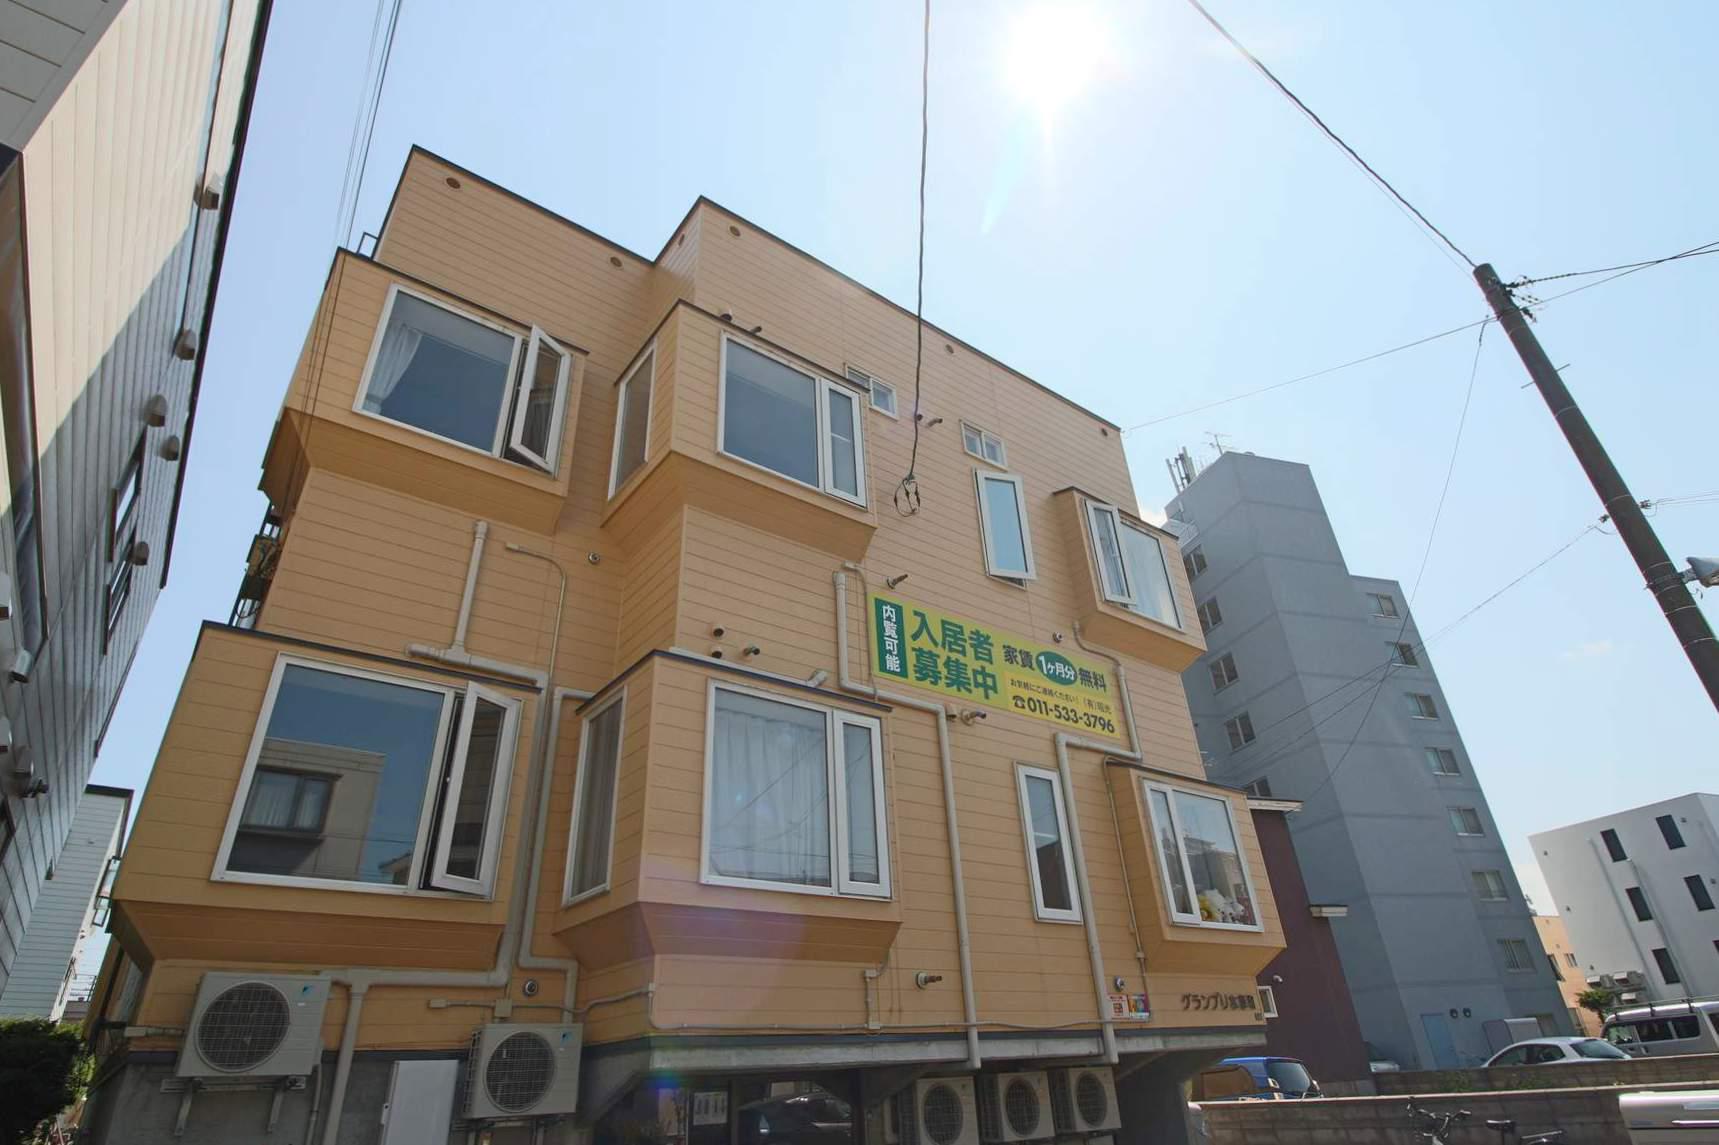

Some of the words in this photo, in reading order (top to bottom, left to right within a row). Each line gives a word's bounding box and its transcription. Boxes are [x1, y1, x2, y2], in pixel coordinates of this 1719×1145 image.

[882, 604, 901, 673] 内覧可能
[911, 609, 994, 666] 入居者
[911, 647, 999, 700] 募集中
[1002, 644, 1036, 671] 家賃
[1078, 667, 1107, 693] 無料
[1026, 696, 1116, 734] 011-533-3796
